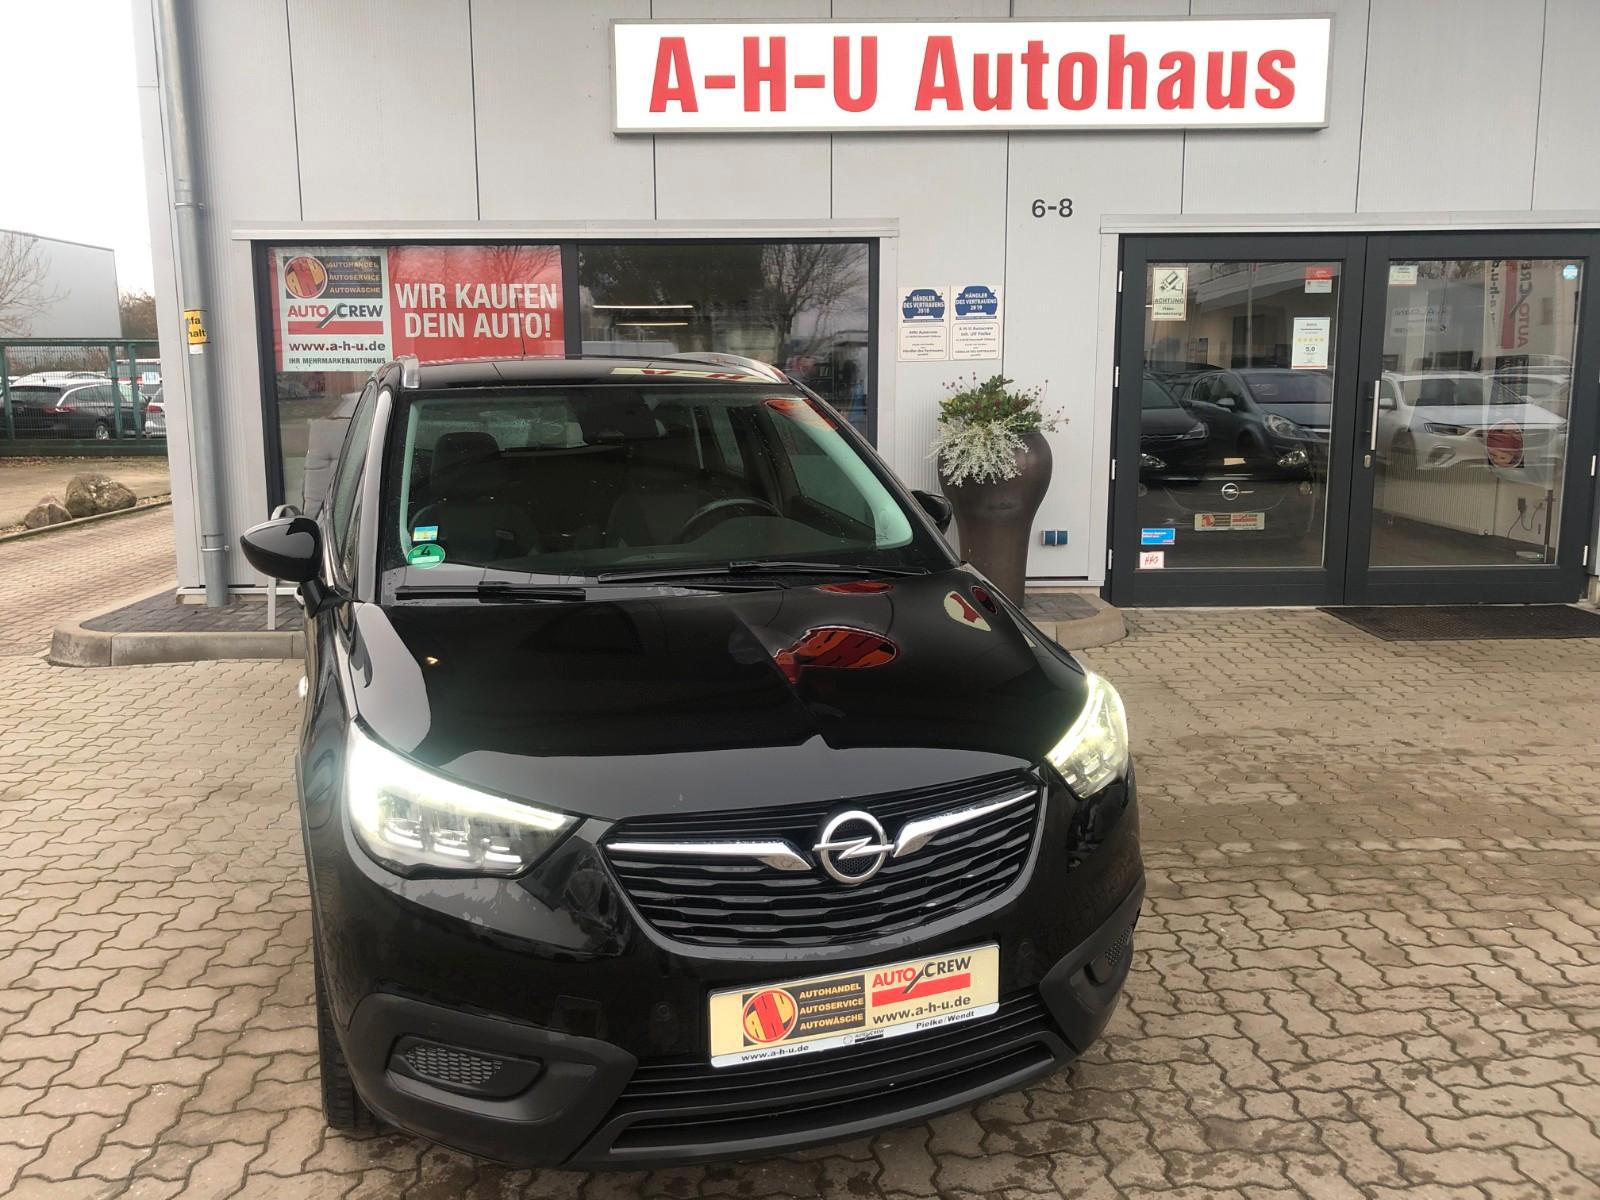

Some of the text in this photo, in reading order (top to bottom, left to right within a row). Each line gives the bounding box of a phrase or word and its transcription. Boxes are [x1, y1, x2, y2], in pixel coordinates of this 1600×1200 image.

[648, 34, 1296, 113] A-H-U Autohaus
[1032, 198, 1072, 218] 6-8
[395, 284, 558, 309] WIR KAUFEN
[405, 313, 550, 338] DEIN AUTO!
[289, 341, 386, 351] www.a-h-u.de
[420, 546, 431, 556] 4
[800, 983, 861, 999] AUTOHANDEL
[800, 998, 864, 1014] AUTOSERVICE
[873, 996, 971, 1024] www.a-h-u.de
[800, 1013, 864, 1030] AUTOWÄSCHE
[916, 1011, 974, 1029] Pielke/Wendt
[741, 1044, 808, 1061] www.a-h-u.de
